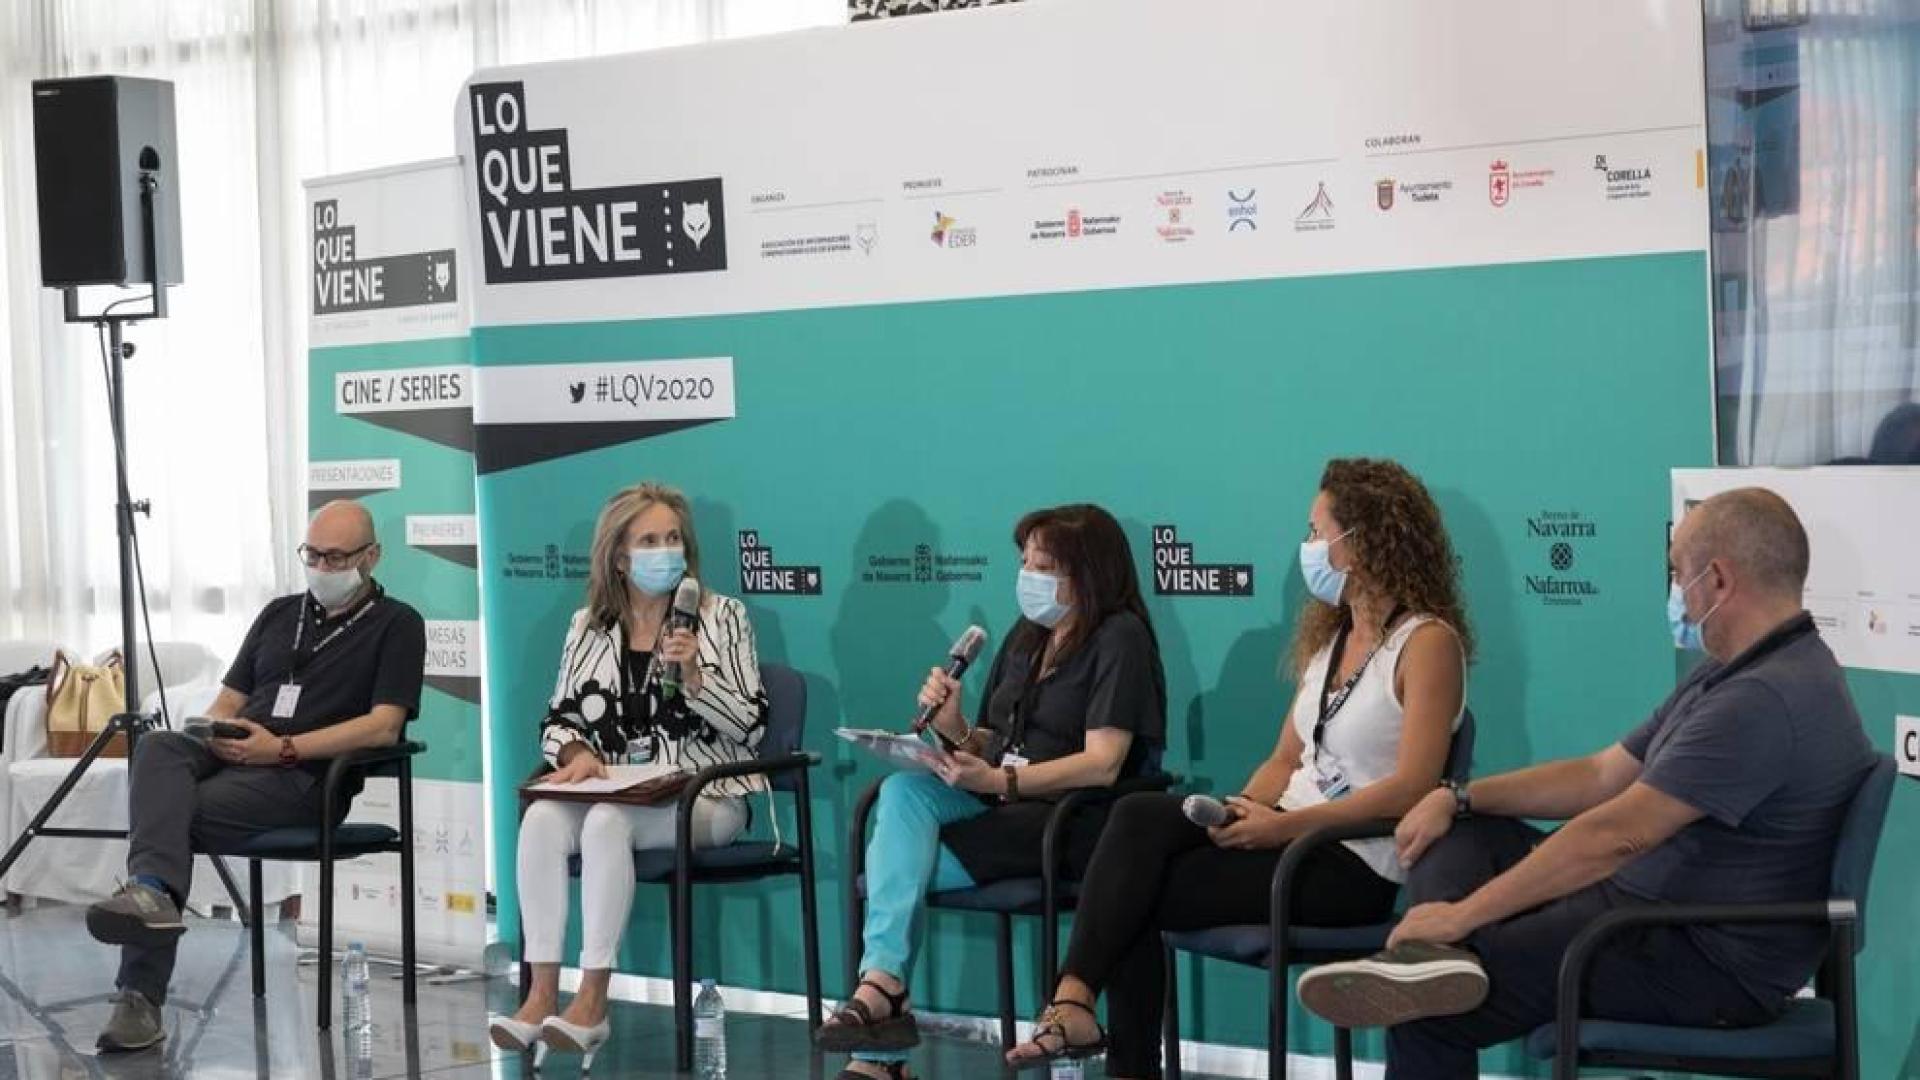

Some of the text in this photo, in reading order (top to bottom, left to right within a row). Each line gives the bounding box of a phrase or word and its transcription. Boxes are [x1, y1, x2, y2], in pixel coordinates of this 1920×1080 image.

[476, 92, 520, 135] LO
[483, 144, 564, 206] QUE
[1607, 167, 1651, 182] CORELLA
[315, 205, 335, 231] LO
[486, 201, 642, 269] VIENE
[316, 234, 352, 270] QUE
[316, 265, 385, 307] VIENE
[342, 373, 461, 405] CINE / SERIES
[595, 373, 715, 407] #LQV2020
[1155, 528, 1174, 543] LO
[1527, 517, 1597, 538] Navarra
[740, 534, 757, 548] LO
[742, 550, 771, 569] QUE
[1156, 548, 1190, 569] QUE
[743, 570, 795, 590] VIENE
[1157, 569, 1221, 591] VIENE
[428, 627, 466, 645] MESAS
[425, 650, 466, 669] ONDAS
